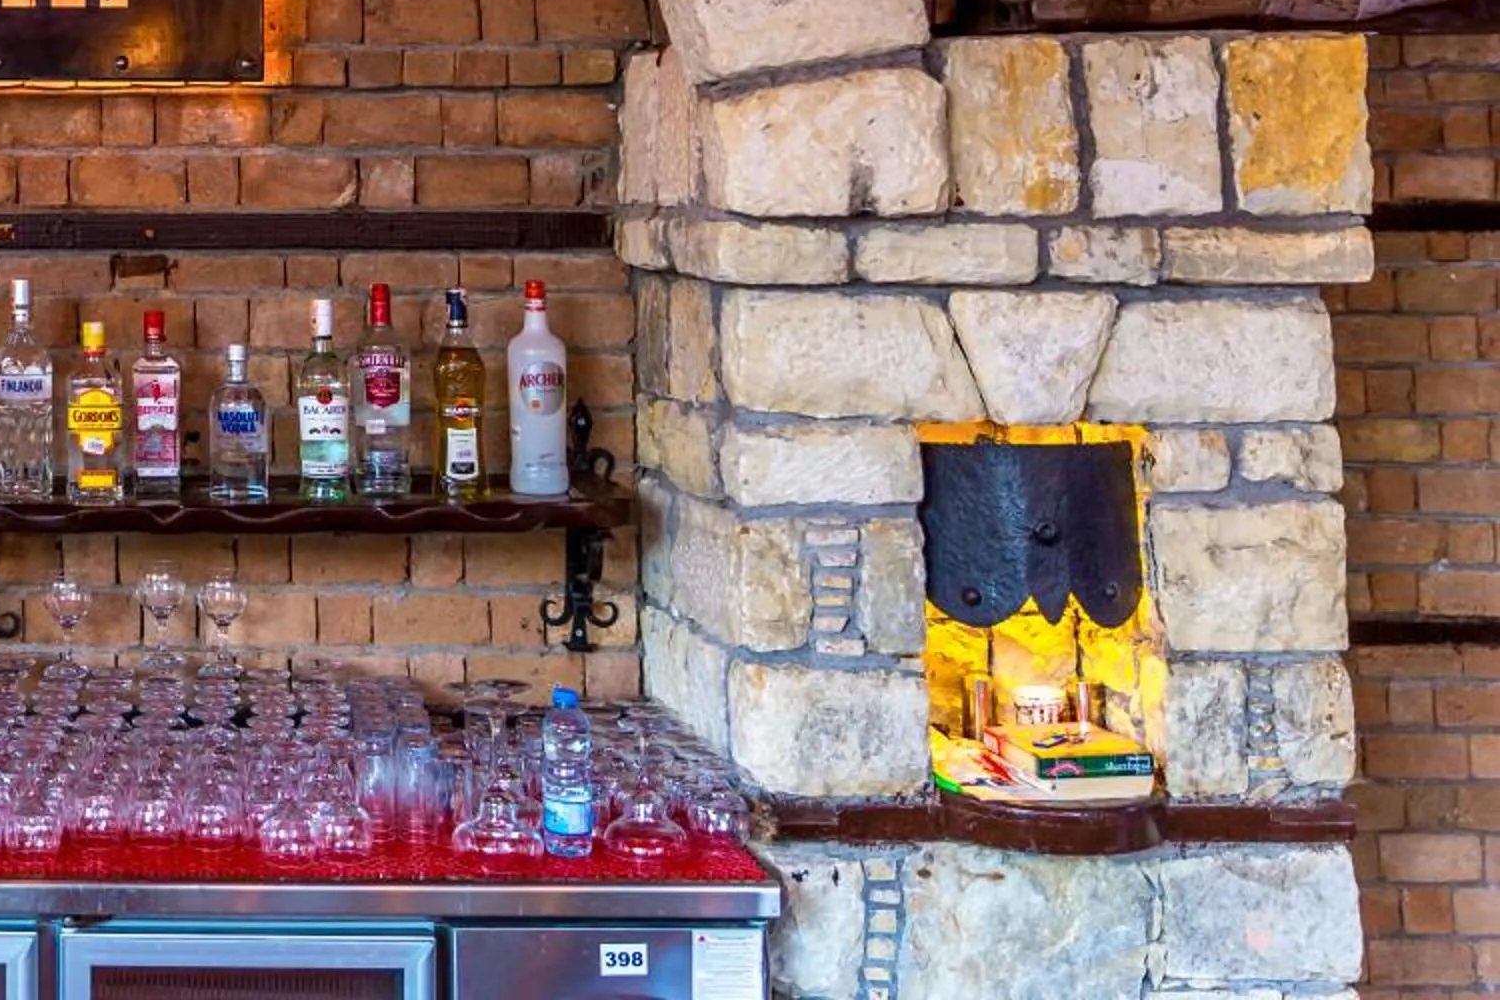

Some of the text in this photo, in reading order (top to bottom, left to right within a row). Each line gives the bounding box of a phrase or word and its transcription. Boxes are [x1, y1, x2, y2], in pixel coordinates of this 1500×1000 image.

[217, 411, 259, 422] ABSOLUT
[221, 421, 257, 434] VODKA
[605, 951, 644, 967] 398
